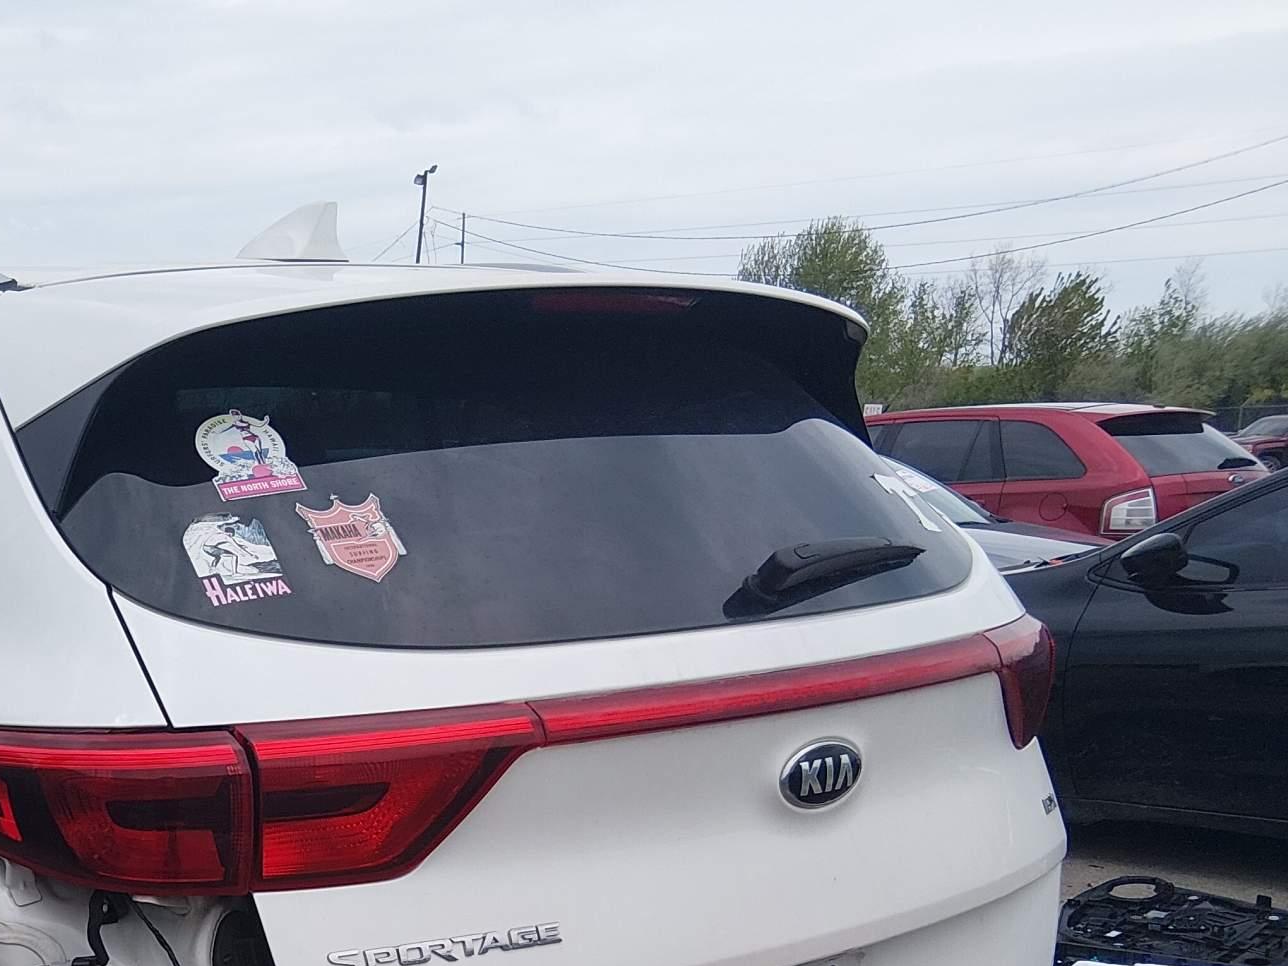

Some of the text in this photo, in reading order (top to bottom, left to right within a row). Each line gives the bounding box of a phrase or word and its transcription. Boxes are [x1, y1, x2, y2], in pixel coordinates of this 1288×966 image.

[222, 477, 301, 496] THE NORTH SHORE
[319, 522, 362, 542] MAKAHA
[799, 753, 853, 796] KIA
